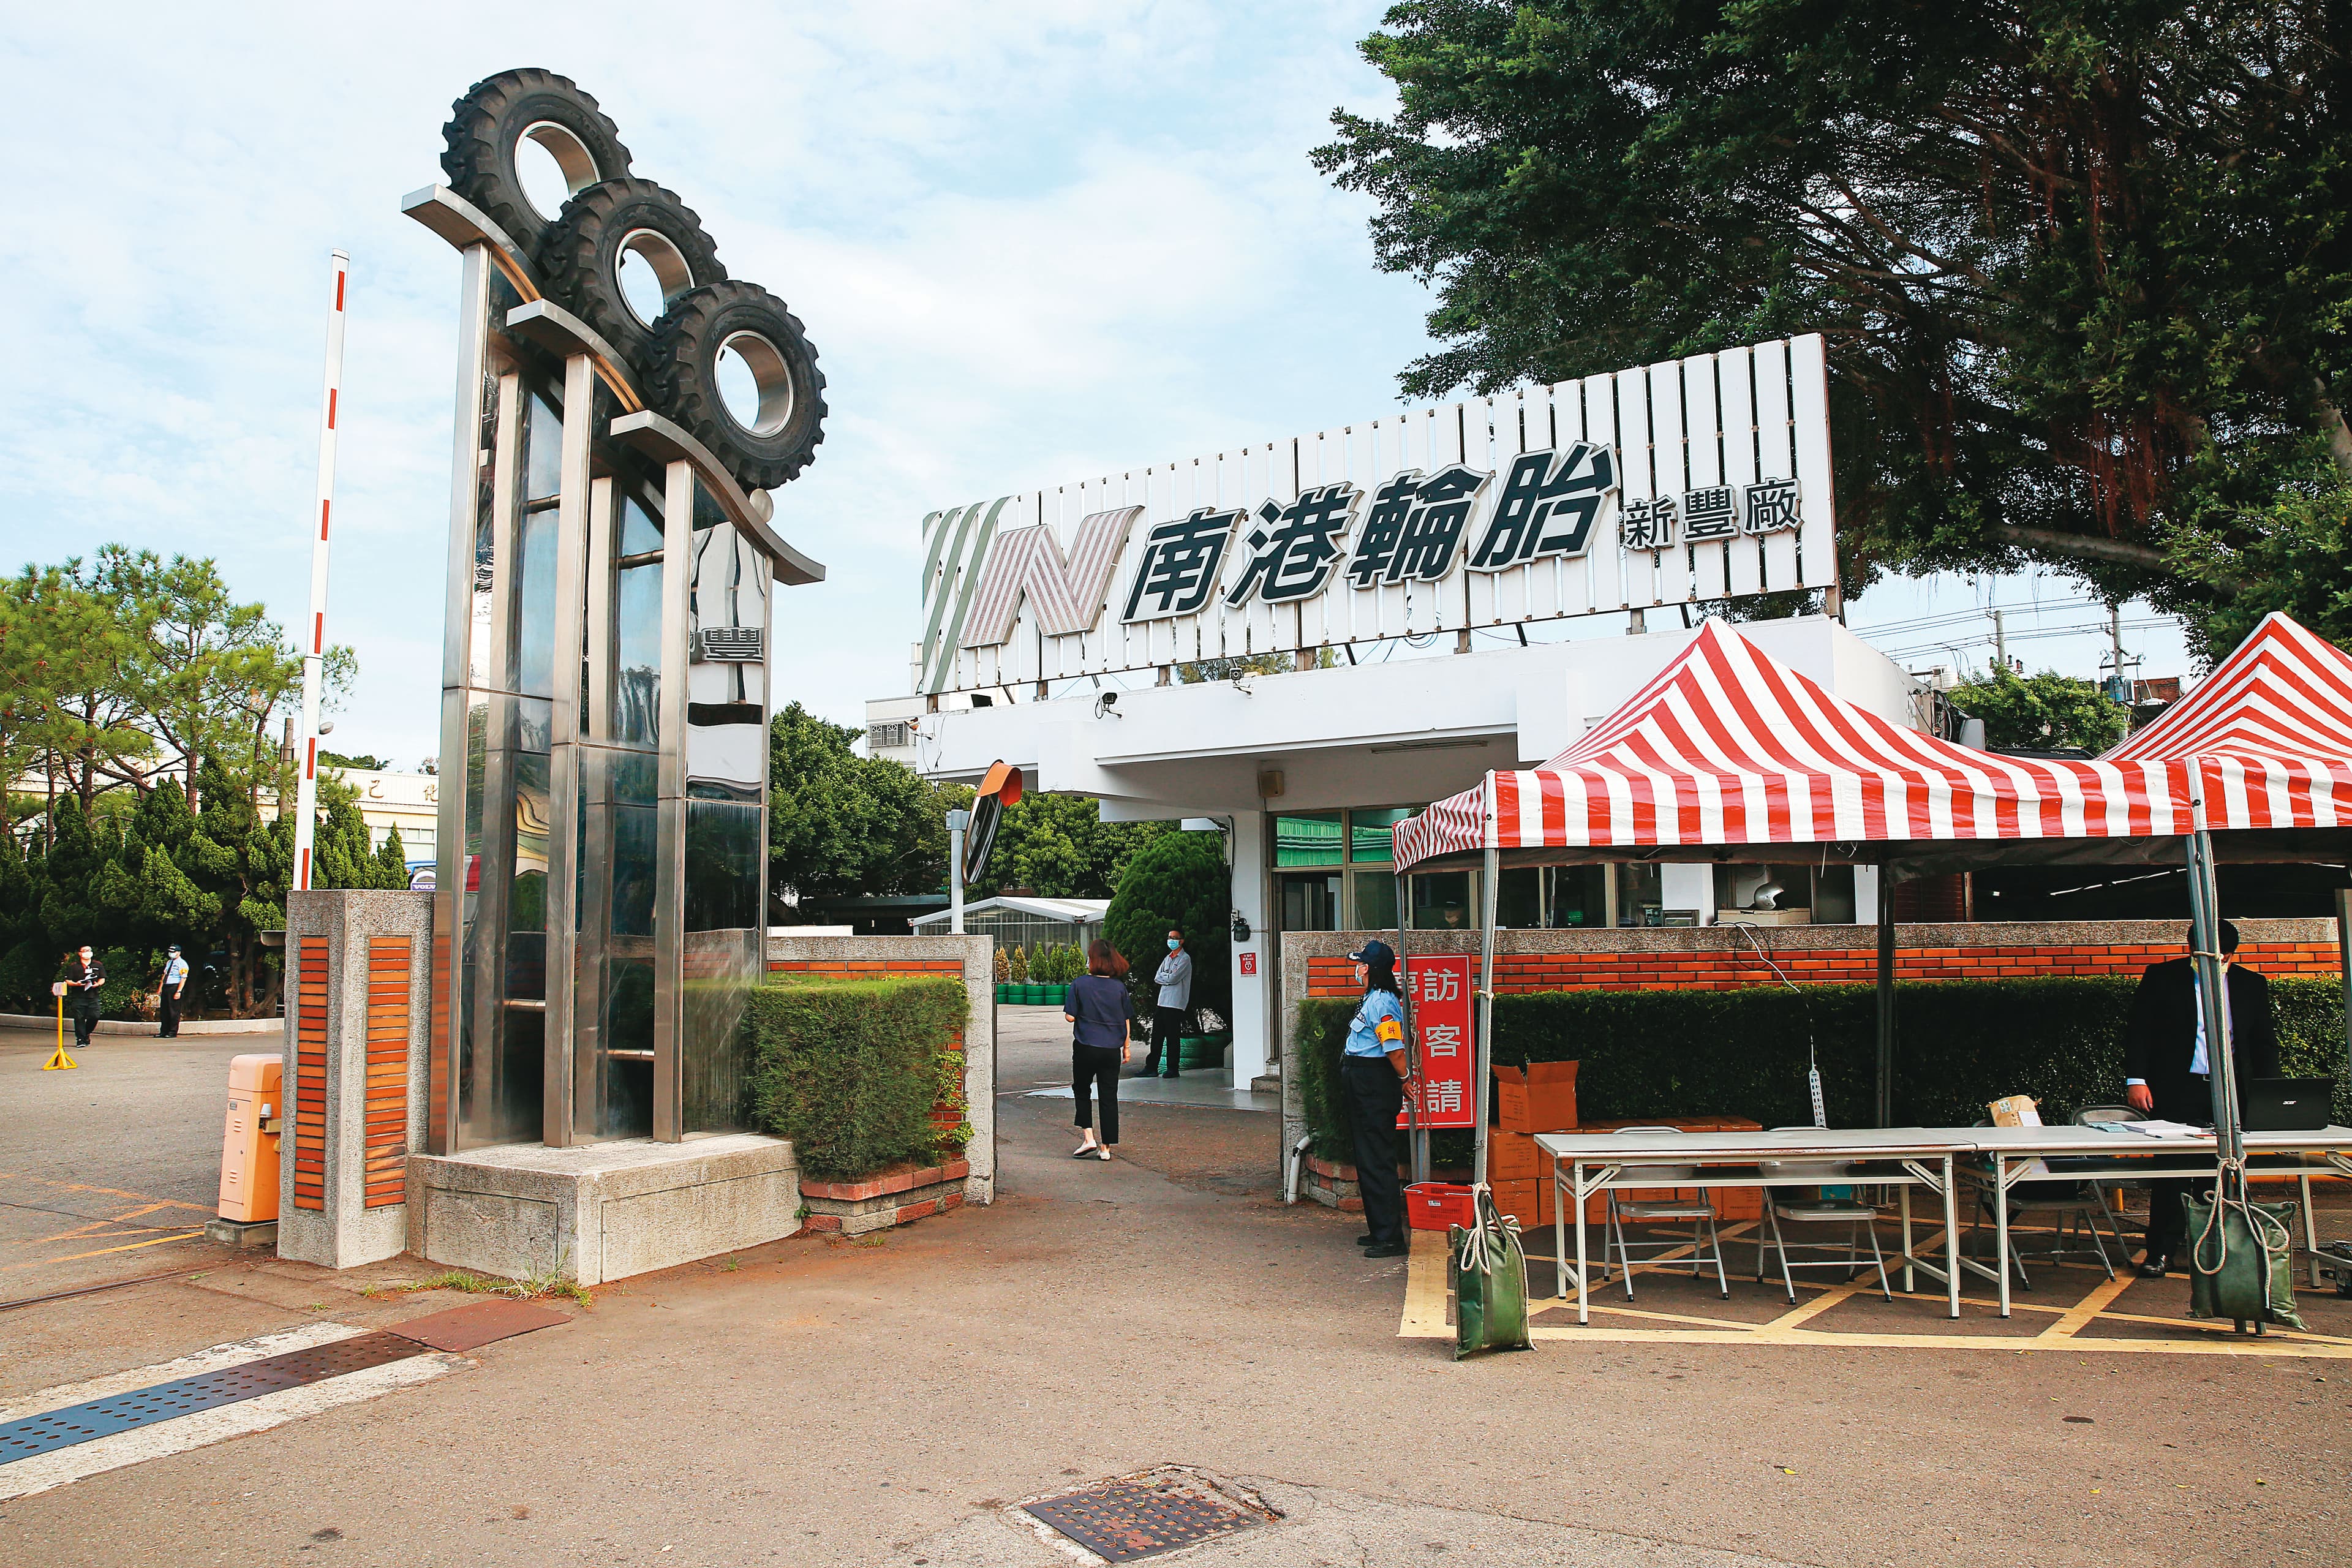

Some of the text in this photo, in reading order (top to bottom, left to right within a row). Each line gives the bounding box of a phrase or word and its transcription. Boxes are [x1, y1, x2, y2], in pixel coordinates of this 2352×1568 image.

[1121, 442, 1617, 622] 南港輪胎
[1624, 479, 1798, 546] 新豐廠
[1423, 968, 1463, 1113] 訪客請
